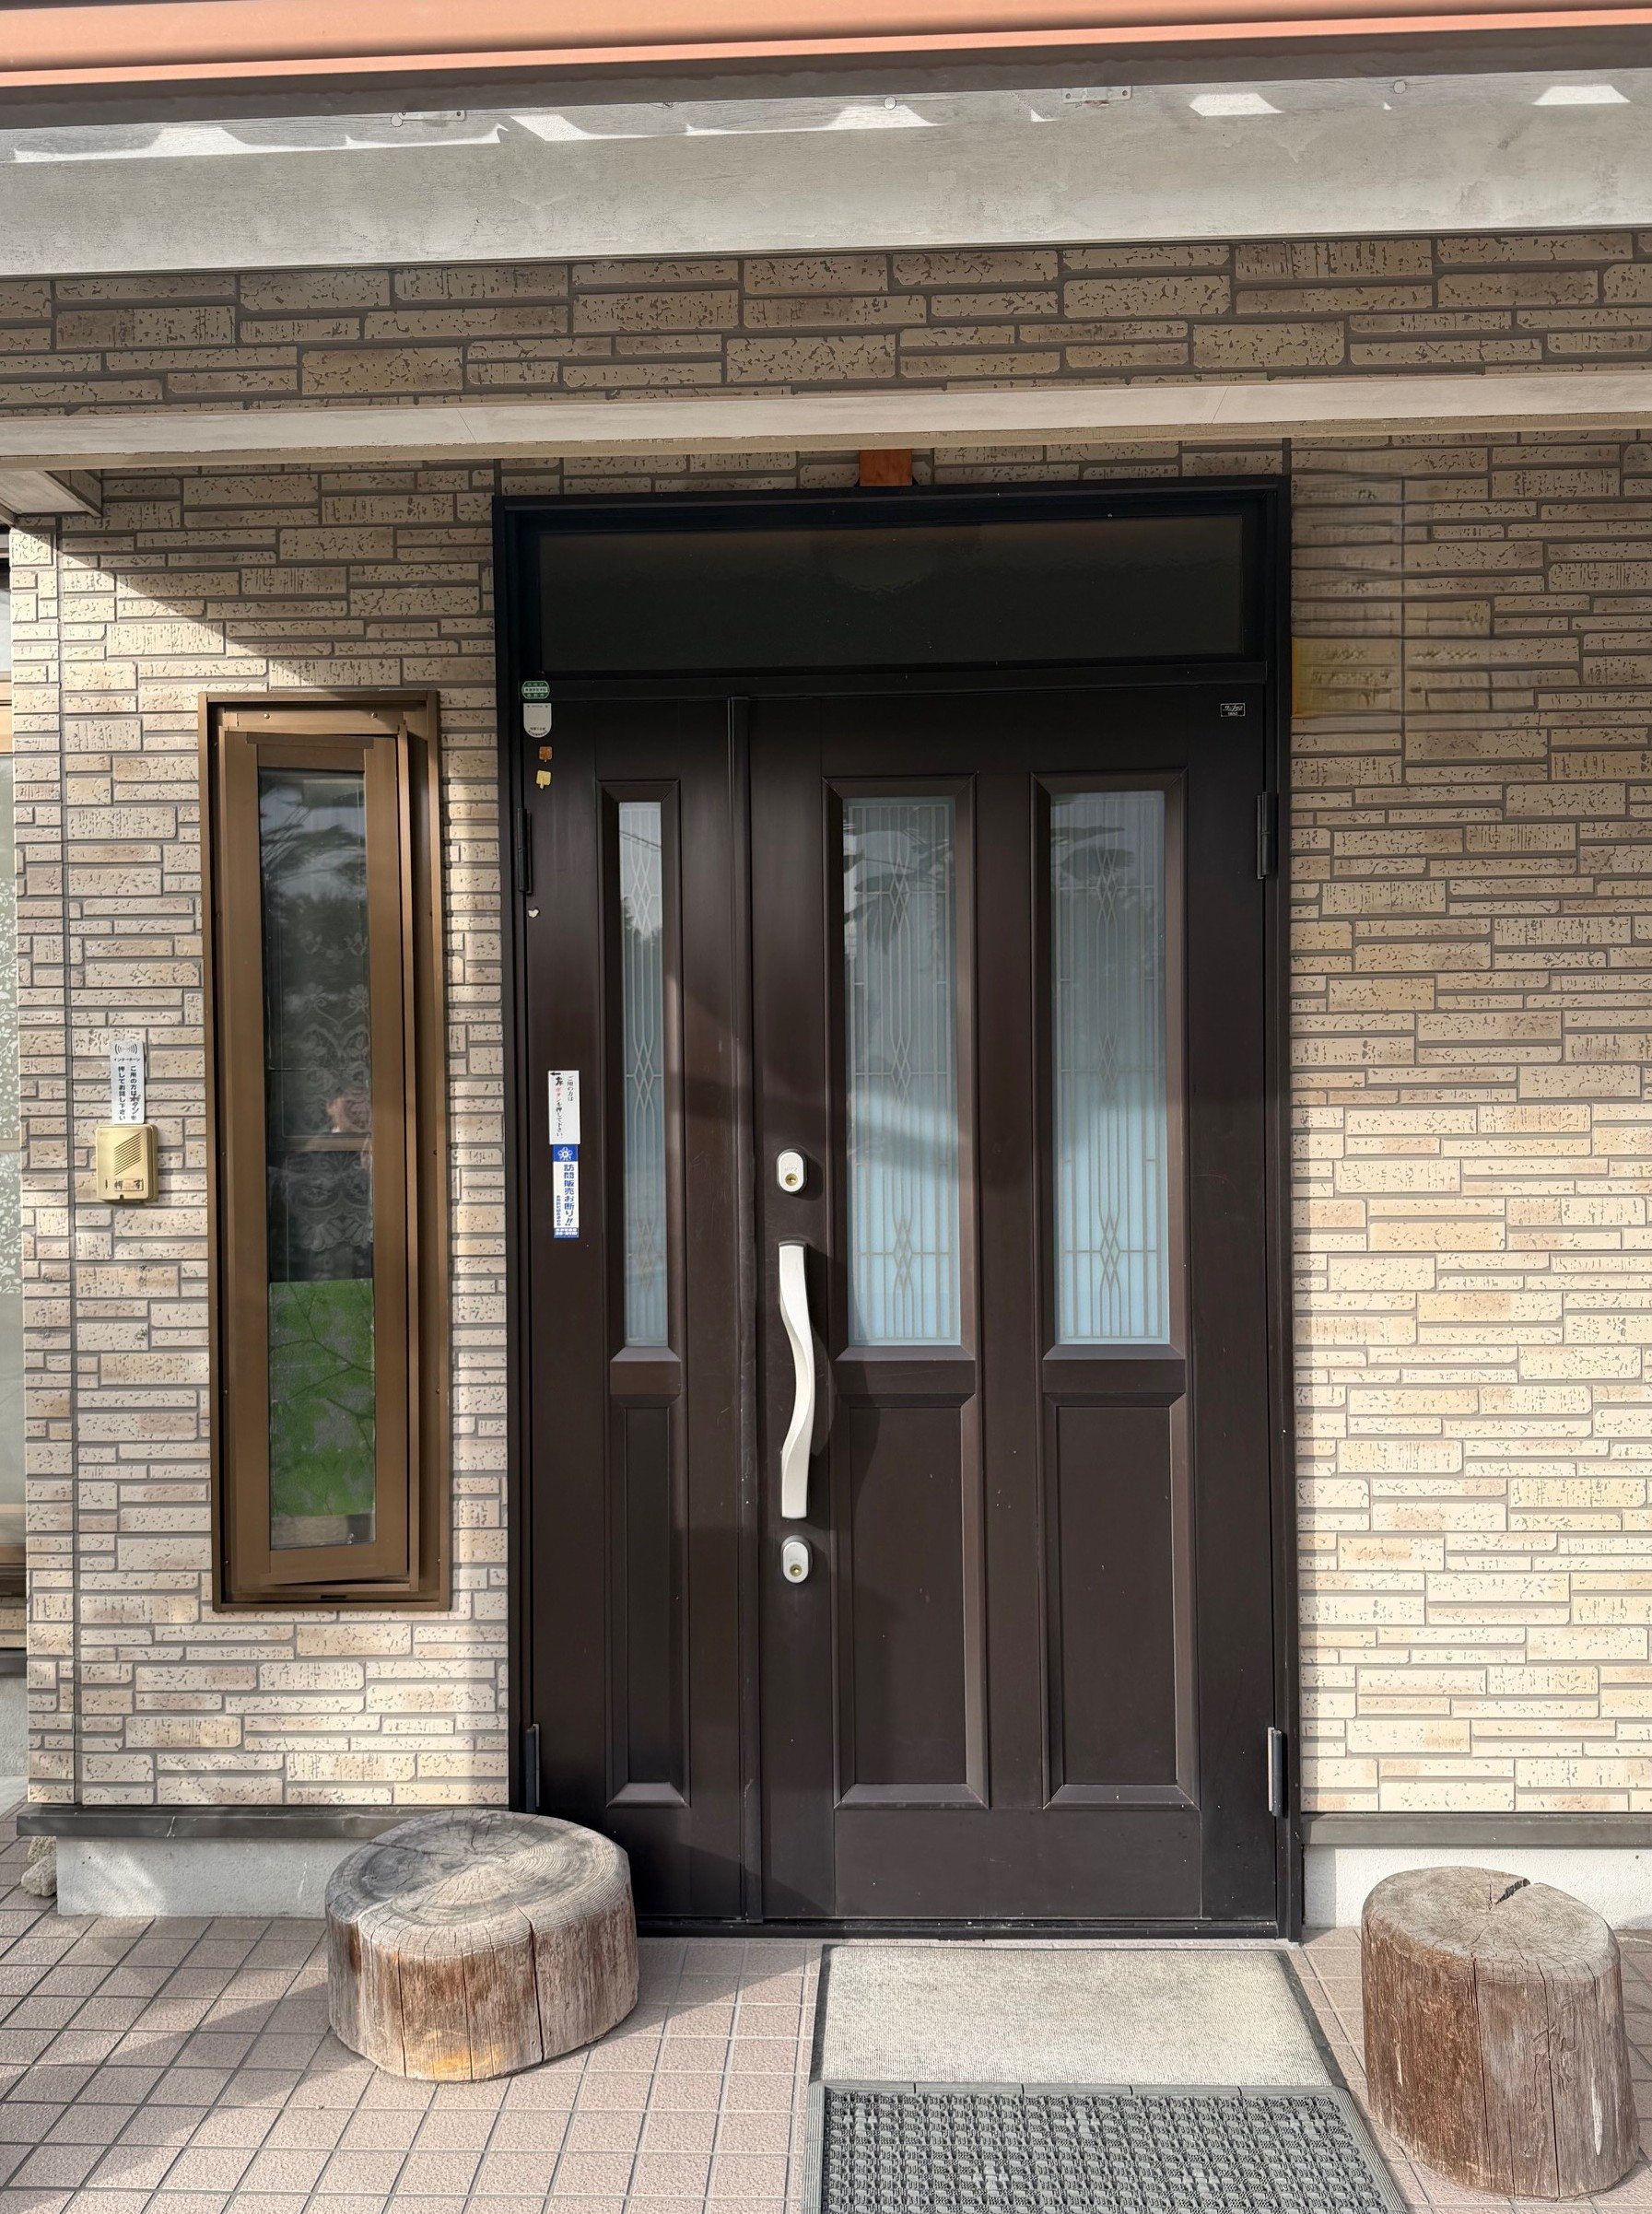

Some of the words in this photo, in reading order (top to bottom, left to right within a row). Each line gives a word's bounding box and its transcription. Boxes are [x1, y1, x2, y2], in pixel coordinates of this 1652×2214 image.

[118, 1066, 126, 1121] 押してお話し下さい
